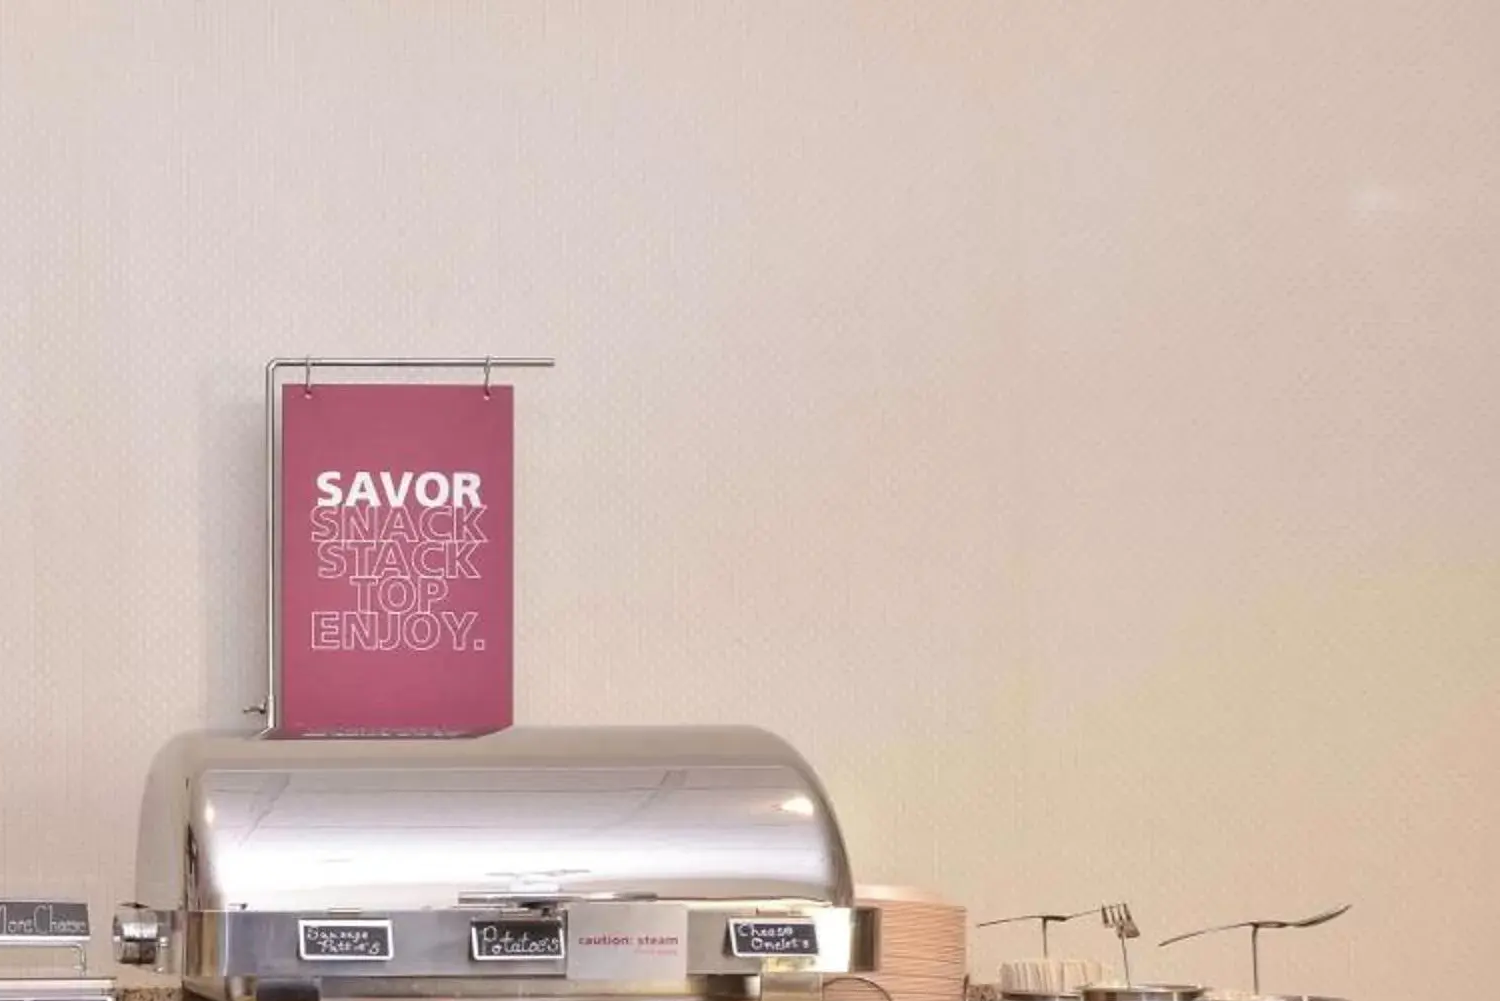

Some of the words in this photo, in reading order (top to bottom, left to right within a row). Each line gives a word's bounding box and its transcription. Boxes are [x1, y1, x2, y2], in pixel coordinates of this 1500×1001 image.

[316, 471, 482, 507] SAVOR
[311, 505, 488, 541] SNACK
[317, 541, 481, 578] STACK
[350, 577, 448, 613] TOP
[311, 612, 485, 650] ENJOY.
[579, 934, 633, 945] caution:
[638, 935, 678, 945] steam
